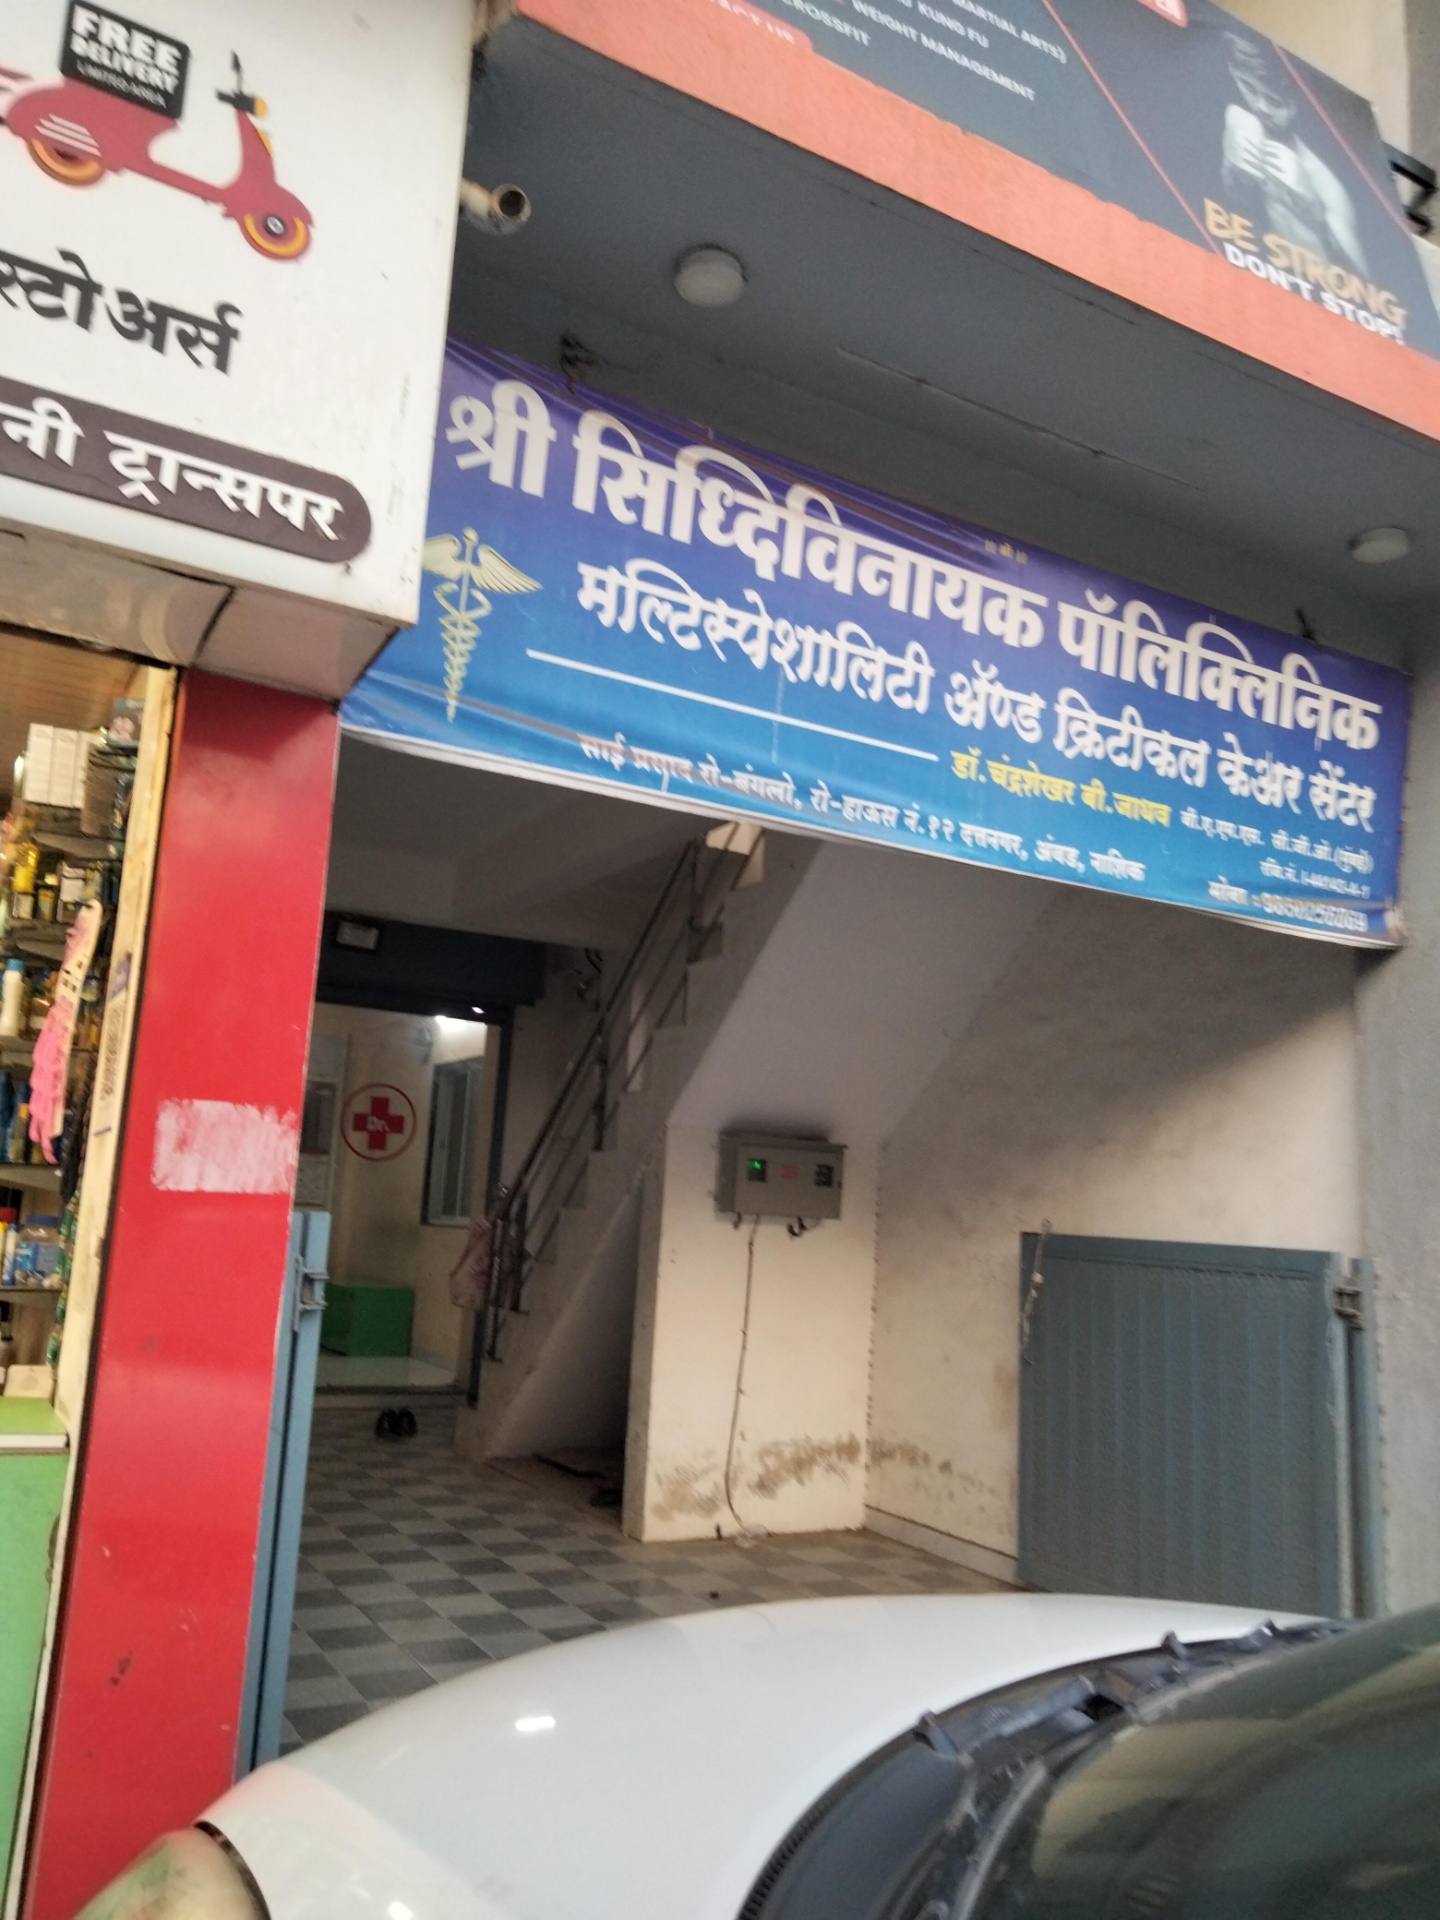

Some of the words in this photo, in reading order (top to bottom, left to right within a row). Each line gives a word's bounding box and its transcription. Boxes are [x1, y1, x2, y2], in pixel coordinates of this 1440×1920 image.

[70, 32, 179, 96] DELIVERY
[72, 4, 182, 78] FREE
[919, 31, 1036, 102] MANAGEMENT
[966, 26, 990, 49] FU
[1203, 197, 1260, 252] BE
[1262, 232, 1408, 332] STRONG
[1222, 241, 1315, 302] DON'T
[445, 379, 557, 499] श्री
[1057, 587, 1383, 751] पॉलिक्लिनिक
[1052, 686, 1212, 789] क्रिटीकल
[1216, 731, 1303, 815] केअर
[1308, 760, 1377, 834] सेंटर
